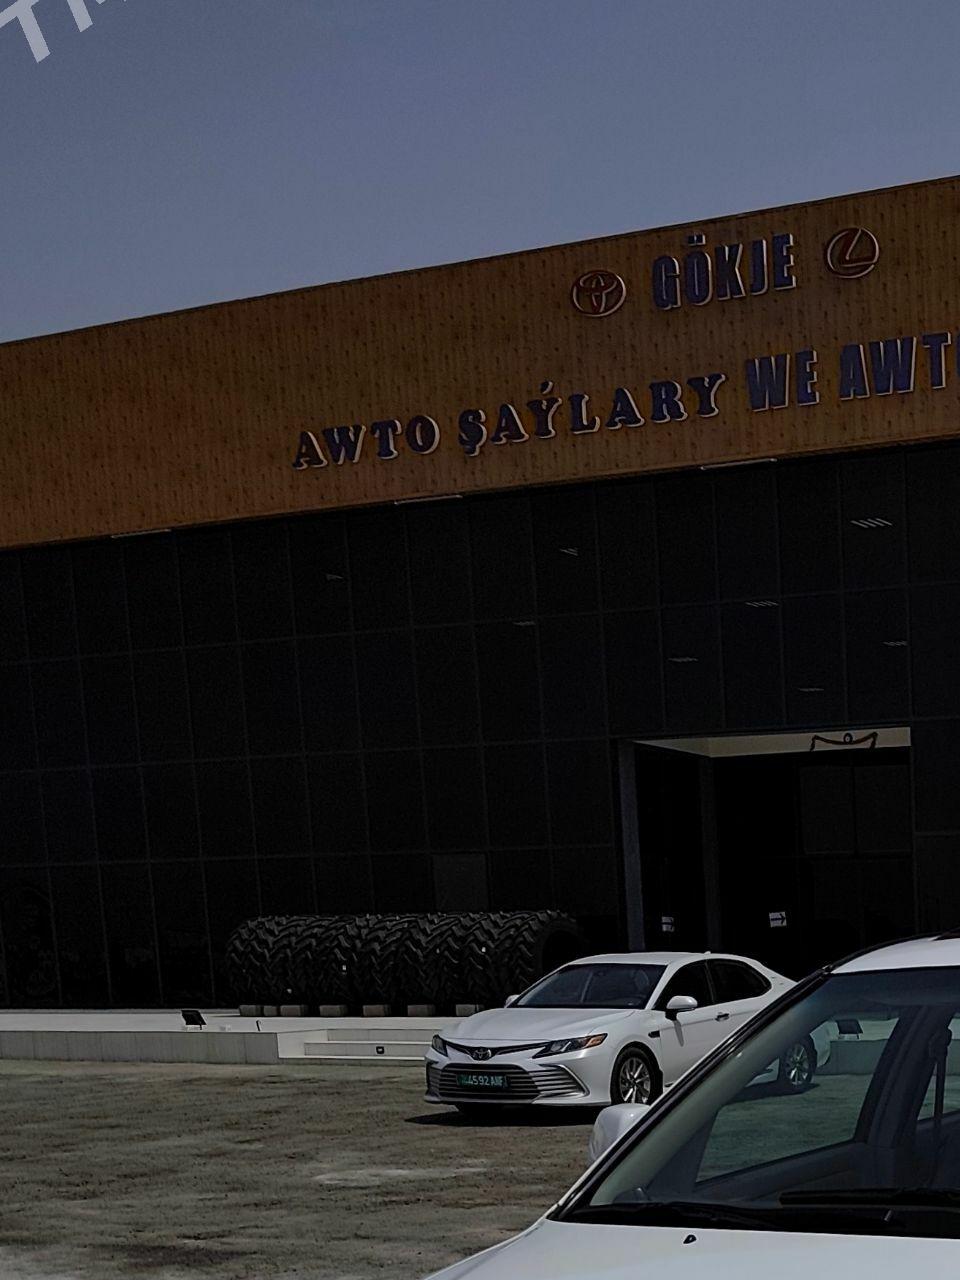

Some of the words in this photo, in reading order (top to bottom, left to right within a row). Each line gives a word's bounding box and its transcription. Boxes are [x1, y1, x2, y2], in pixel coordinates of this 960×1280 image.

[652, 232, 797, 311] GÖKJE
[292, 413, 440, 471] AWTO
[457, 372, 728, 458] ŞAÝLARY
[745, 350, 820, 413] WE
